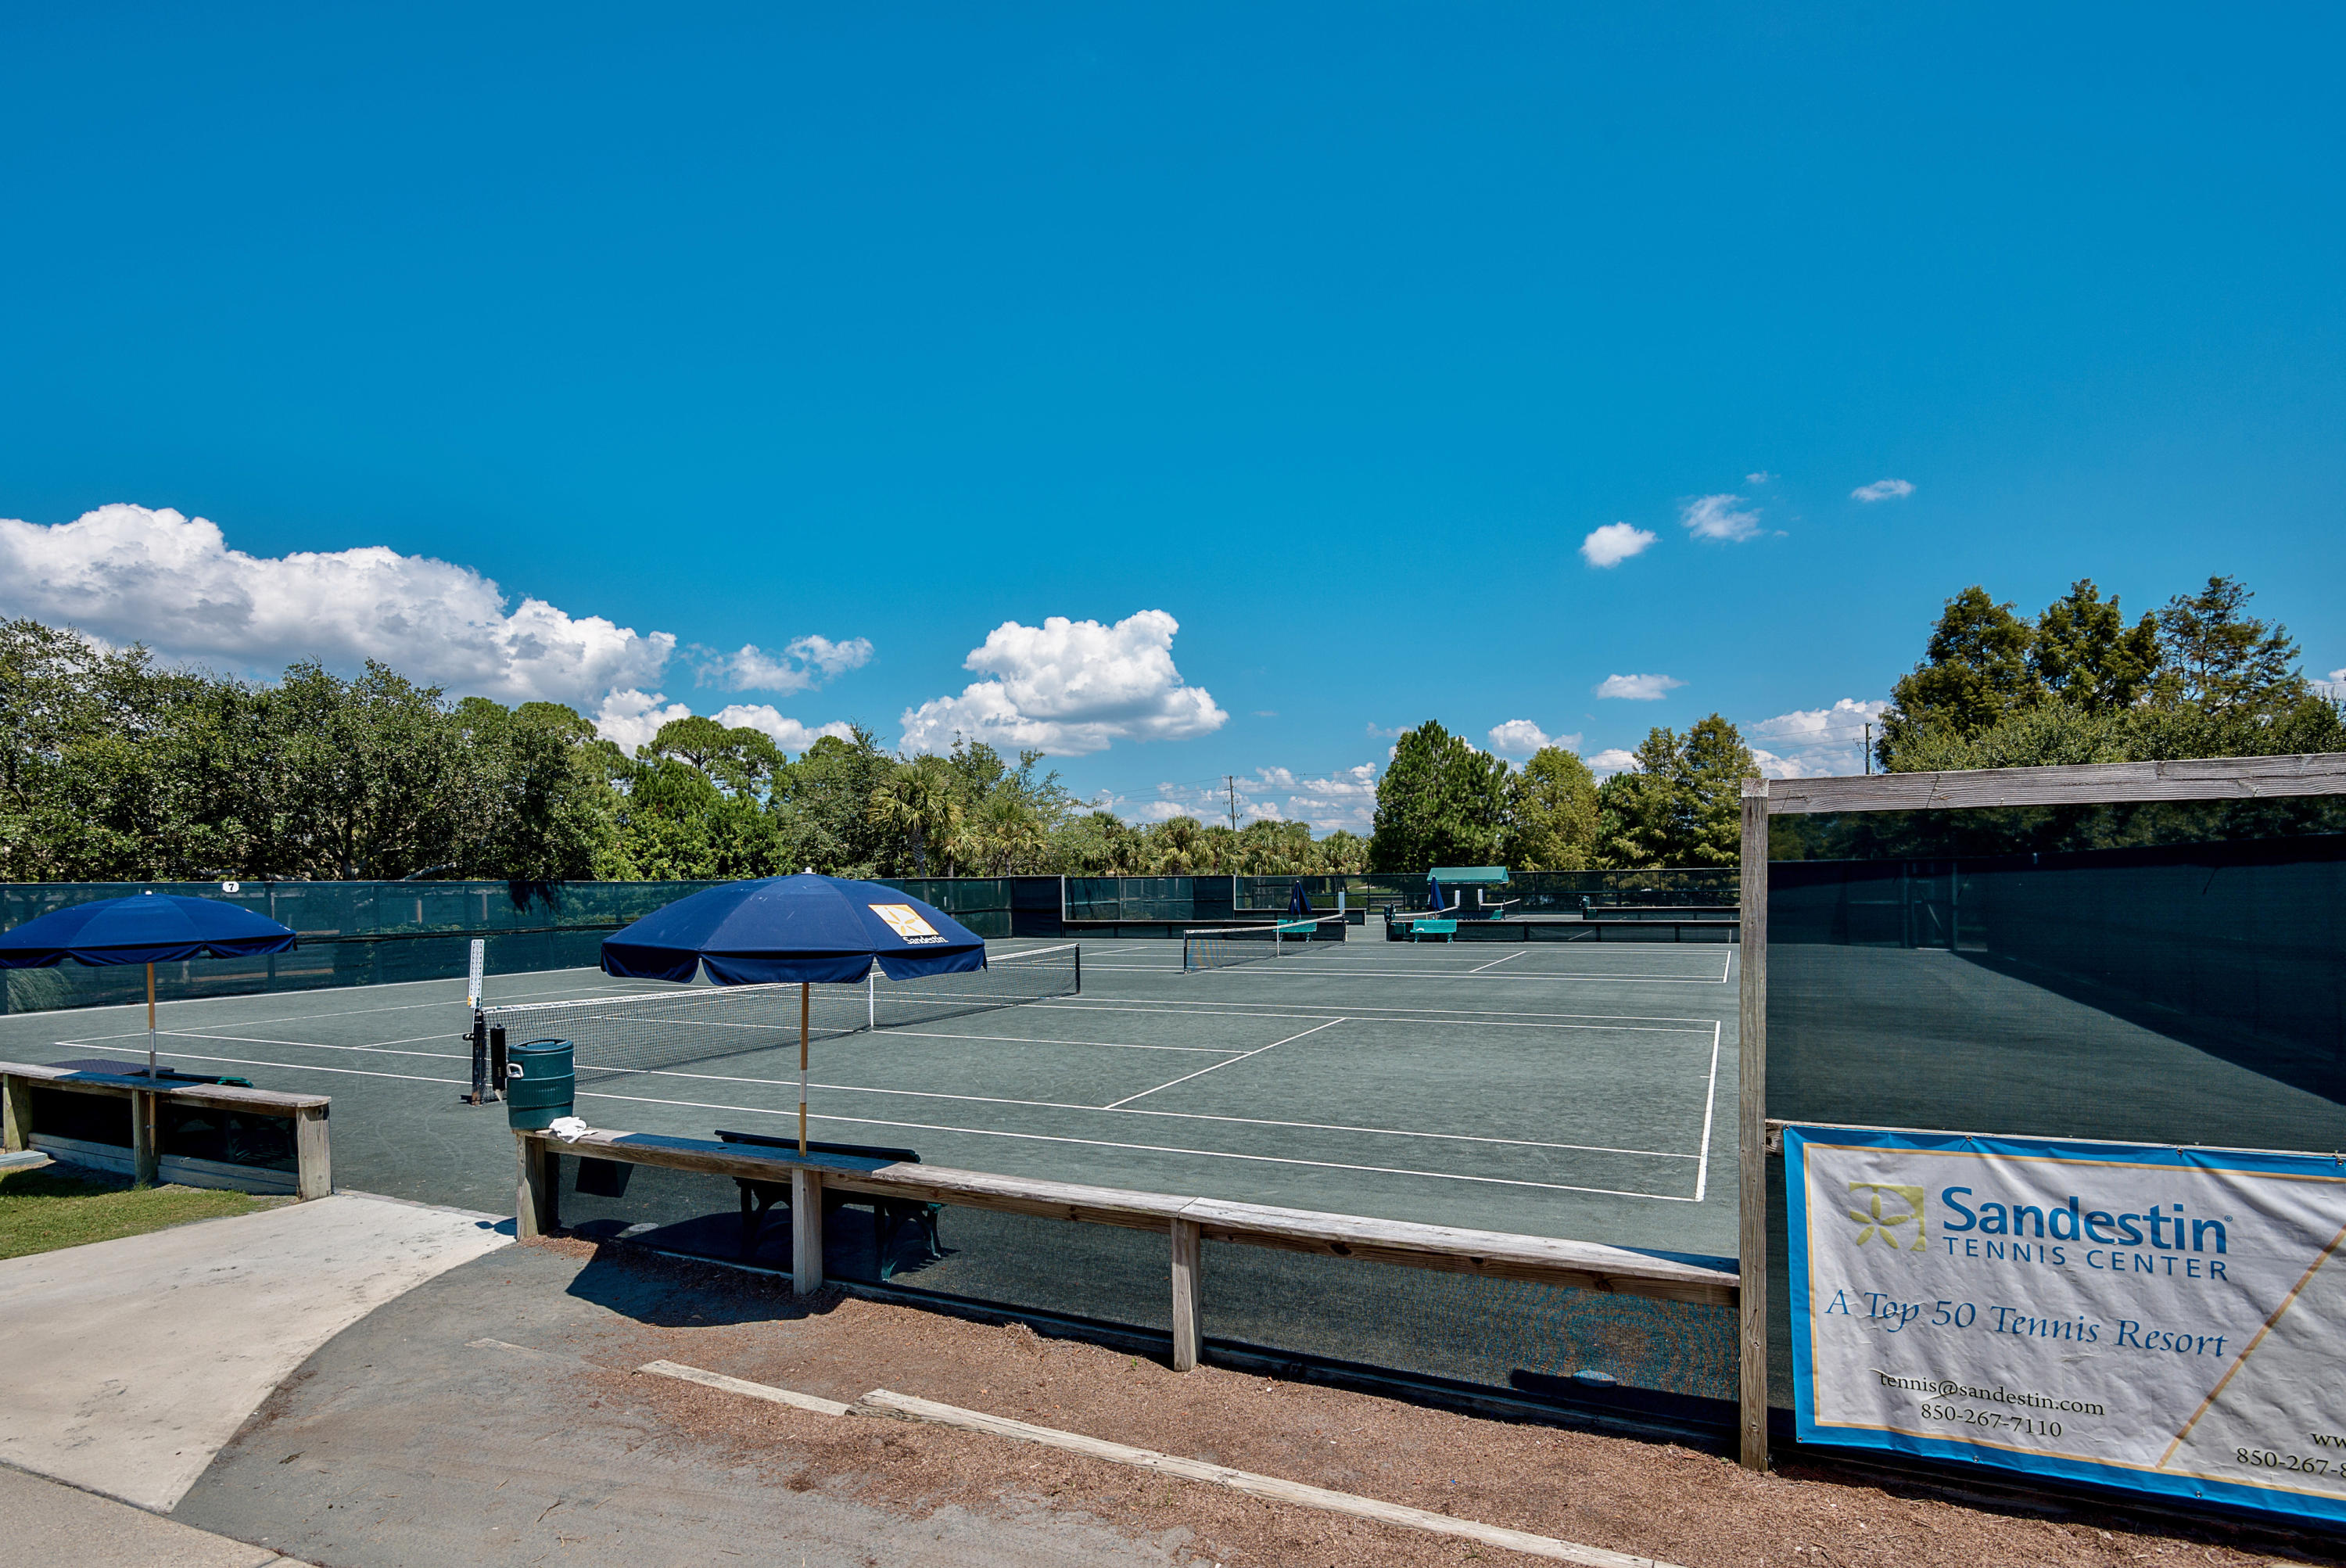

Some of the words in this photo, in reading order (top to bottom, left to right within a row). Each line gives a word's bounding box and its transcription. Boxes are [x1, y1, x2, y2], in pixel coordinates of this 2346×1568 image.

[1942, 1236, 2066, 1265] TENNIS
[2086, 1250, 2229, 1281] CENTER
[1824, 1289, 1852, 1315] A
[1864, 1292, 1920, 1333] Top
[1932, 1301, 1976, 1328] 50
[1990, 1305, 2100, 1344] Tennis
[2114, 1319, 2229, 1358] Resort
[1879, 1372, 2106, 1416] tennis@sandestin.com
[1921, 1403, 2062, 1437] 850-267-7110
